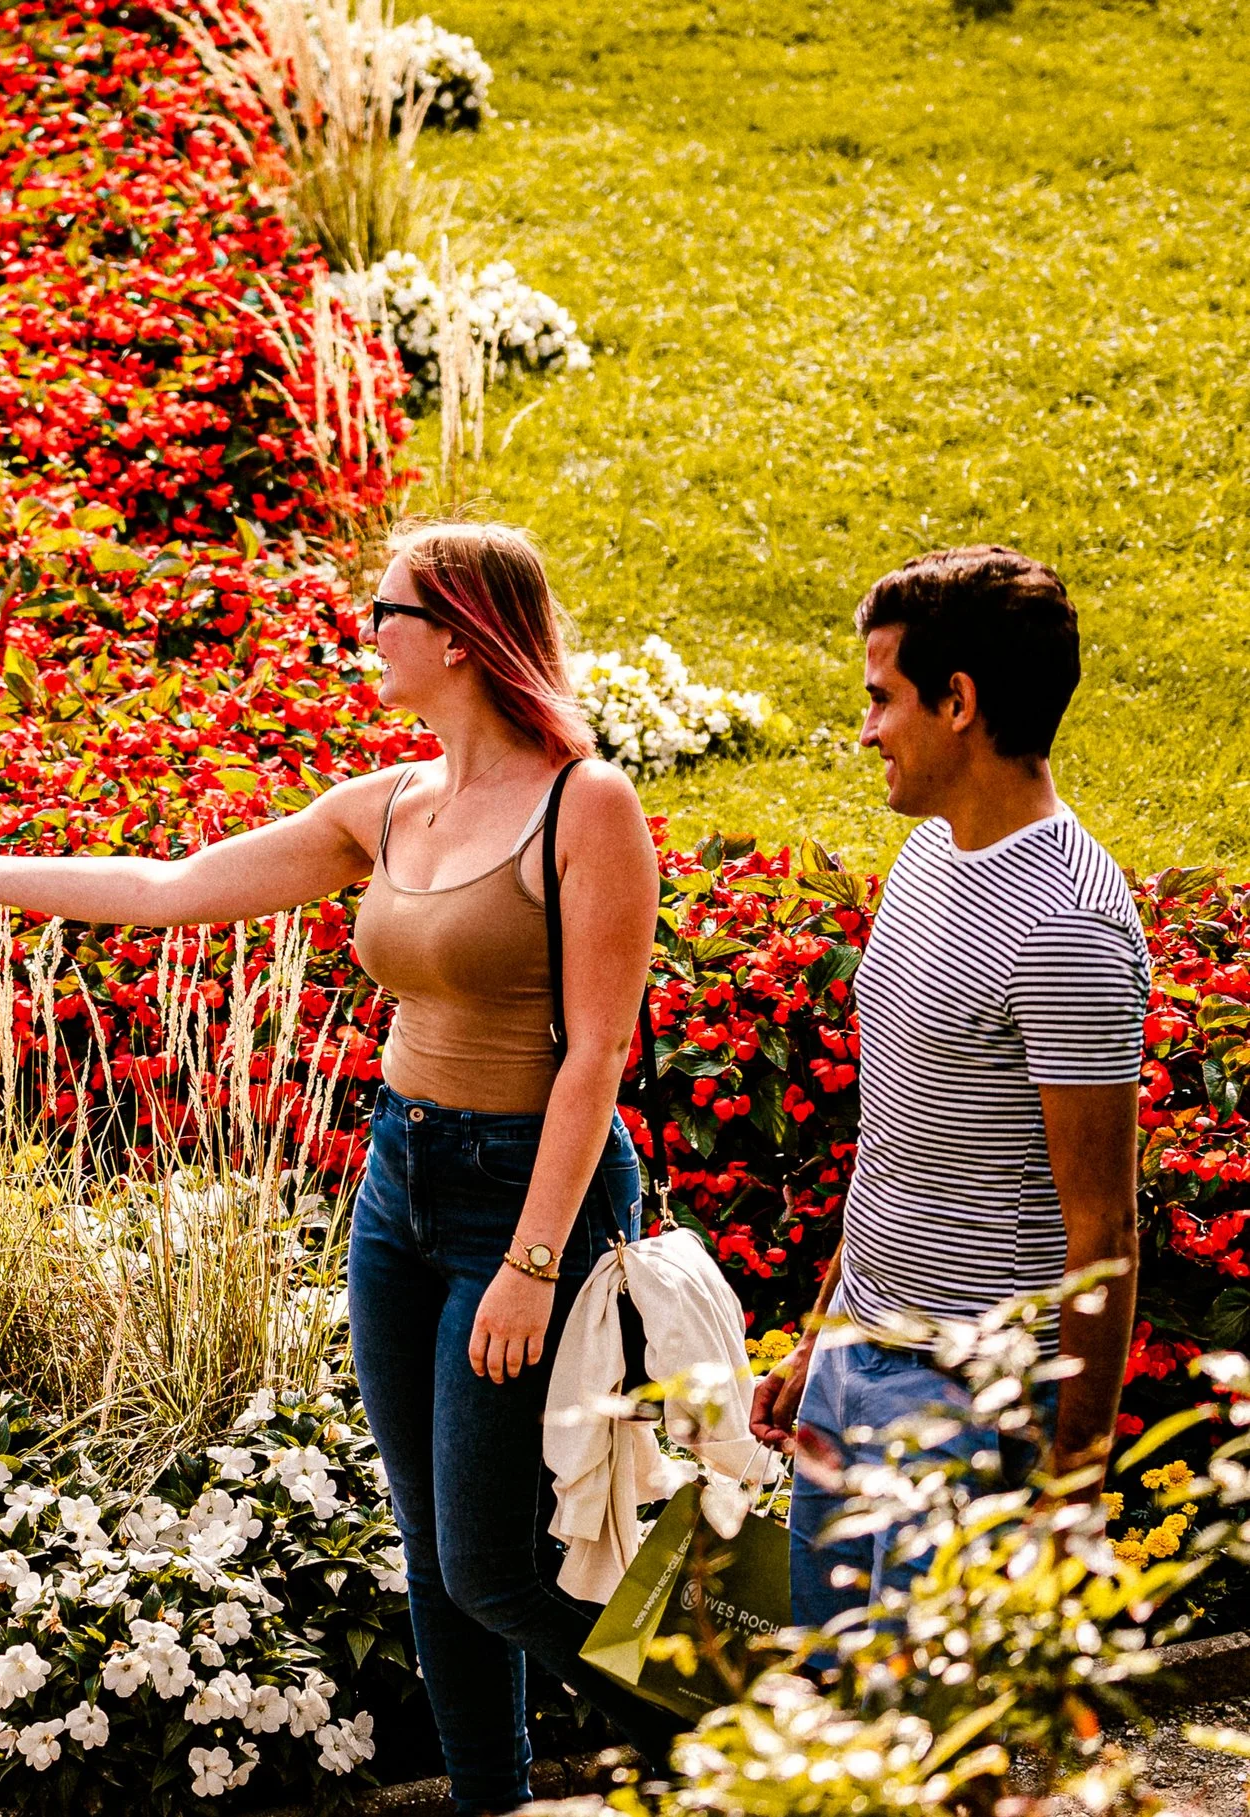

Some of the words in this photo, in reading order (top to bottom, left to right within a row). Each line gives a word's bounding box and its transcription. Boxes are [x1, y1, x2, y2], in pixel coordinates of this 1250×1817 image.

[643, 1585, 662, 1611] PAPIER
[704, 1594, 735, 1618] YVES
[738, 1610, 779, 1636] ROCH
[716, 1617, 753, 1637] FRAN
